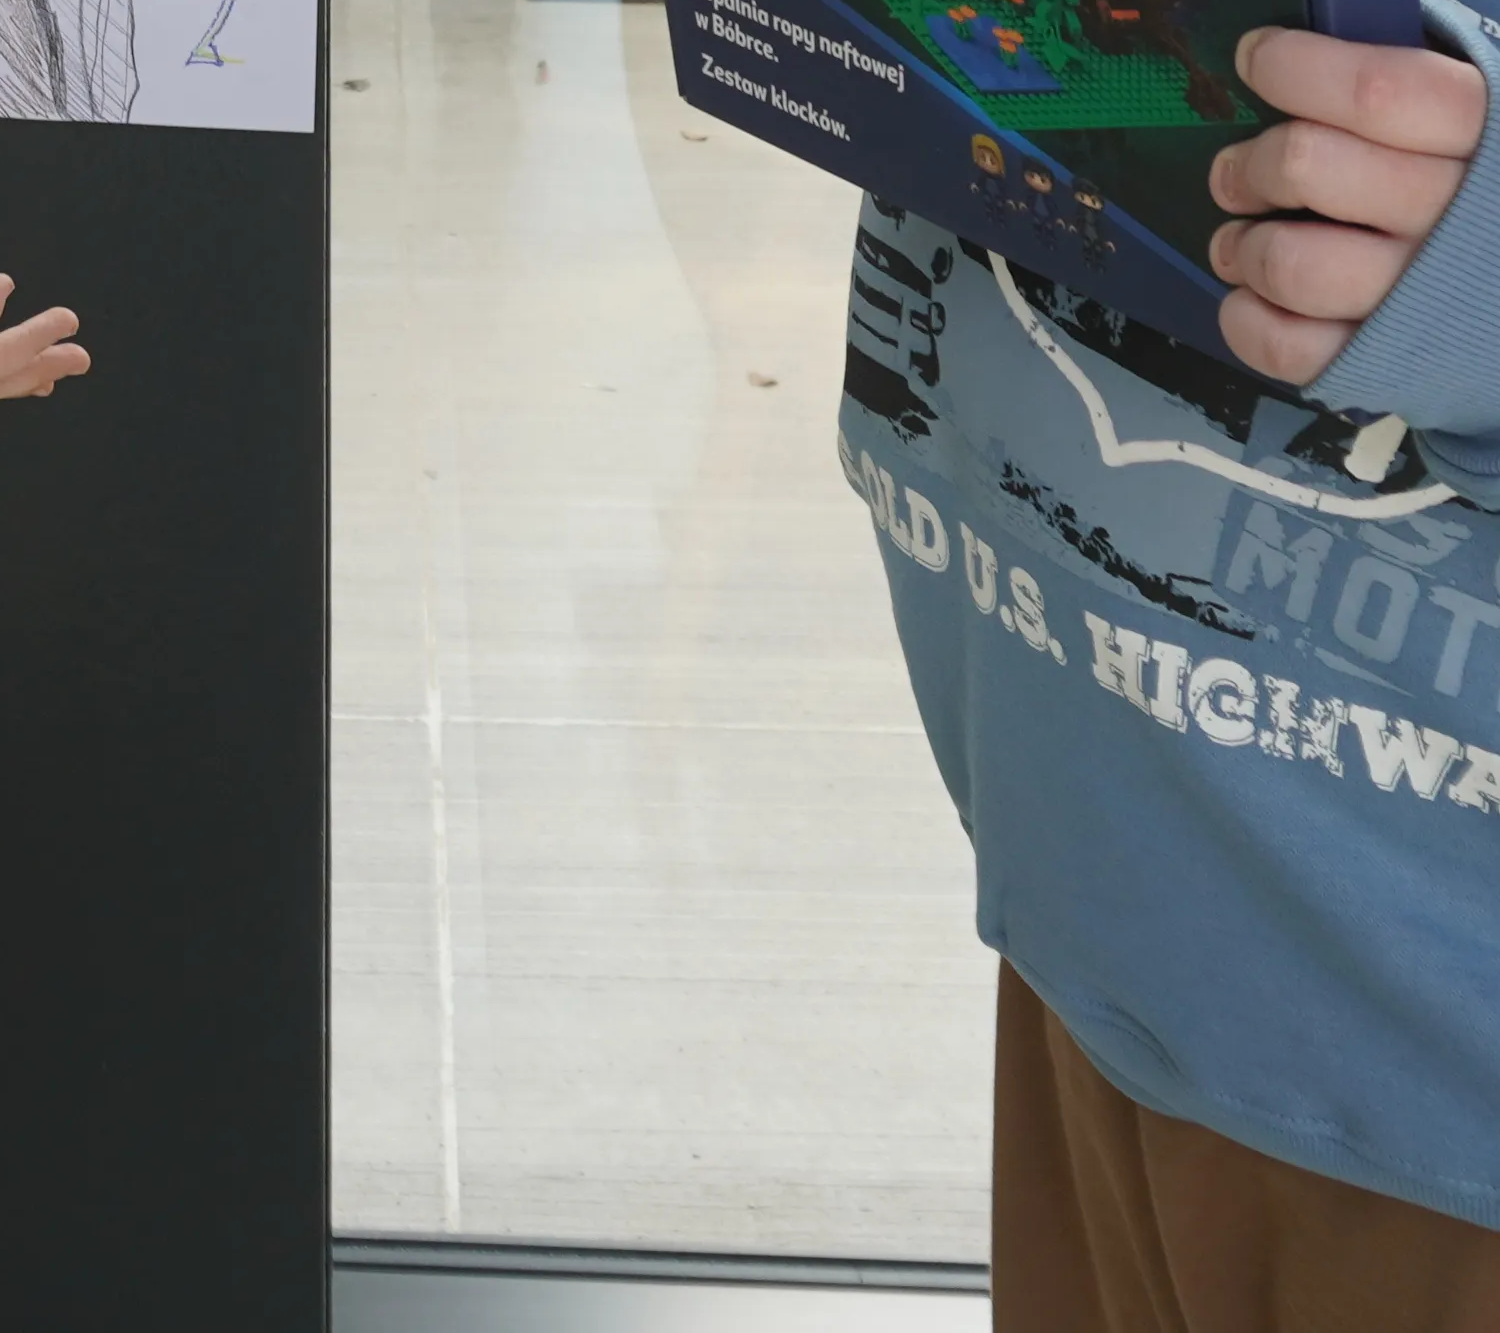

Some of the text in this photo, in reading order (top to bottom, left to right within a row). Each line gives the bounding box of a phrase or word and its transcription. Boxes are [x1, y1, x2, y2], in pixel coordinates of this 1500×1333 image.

[694, 11, 780, 63] w Bóbrce.
[772, 14, 815, 54] ropy
[819, 36, 905, 93] naftowej
[701, 52, 851, 142] Zestaw klocków.
[860, 449, 950, 573] OLD
[961, 521, 1067, 666] U.S.
